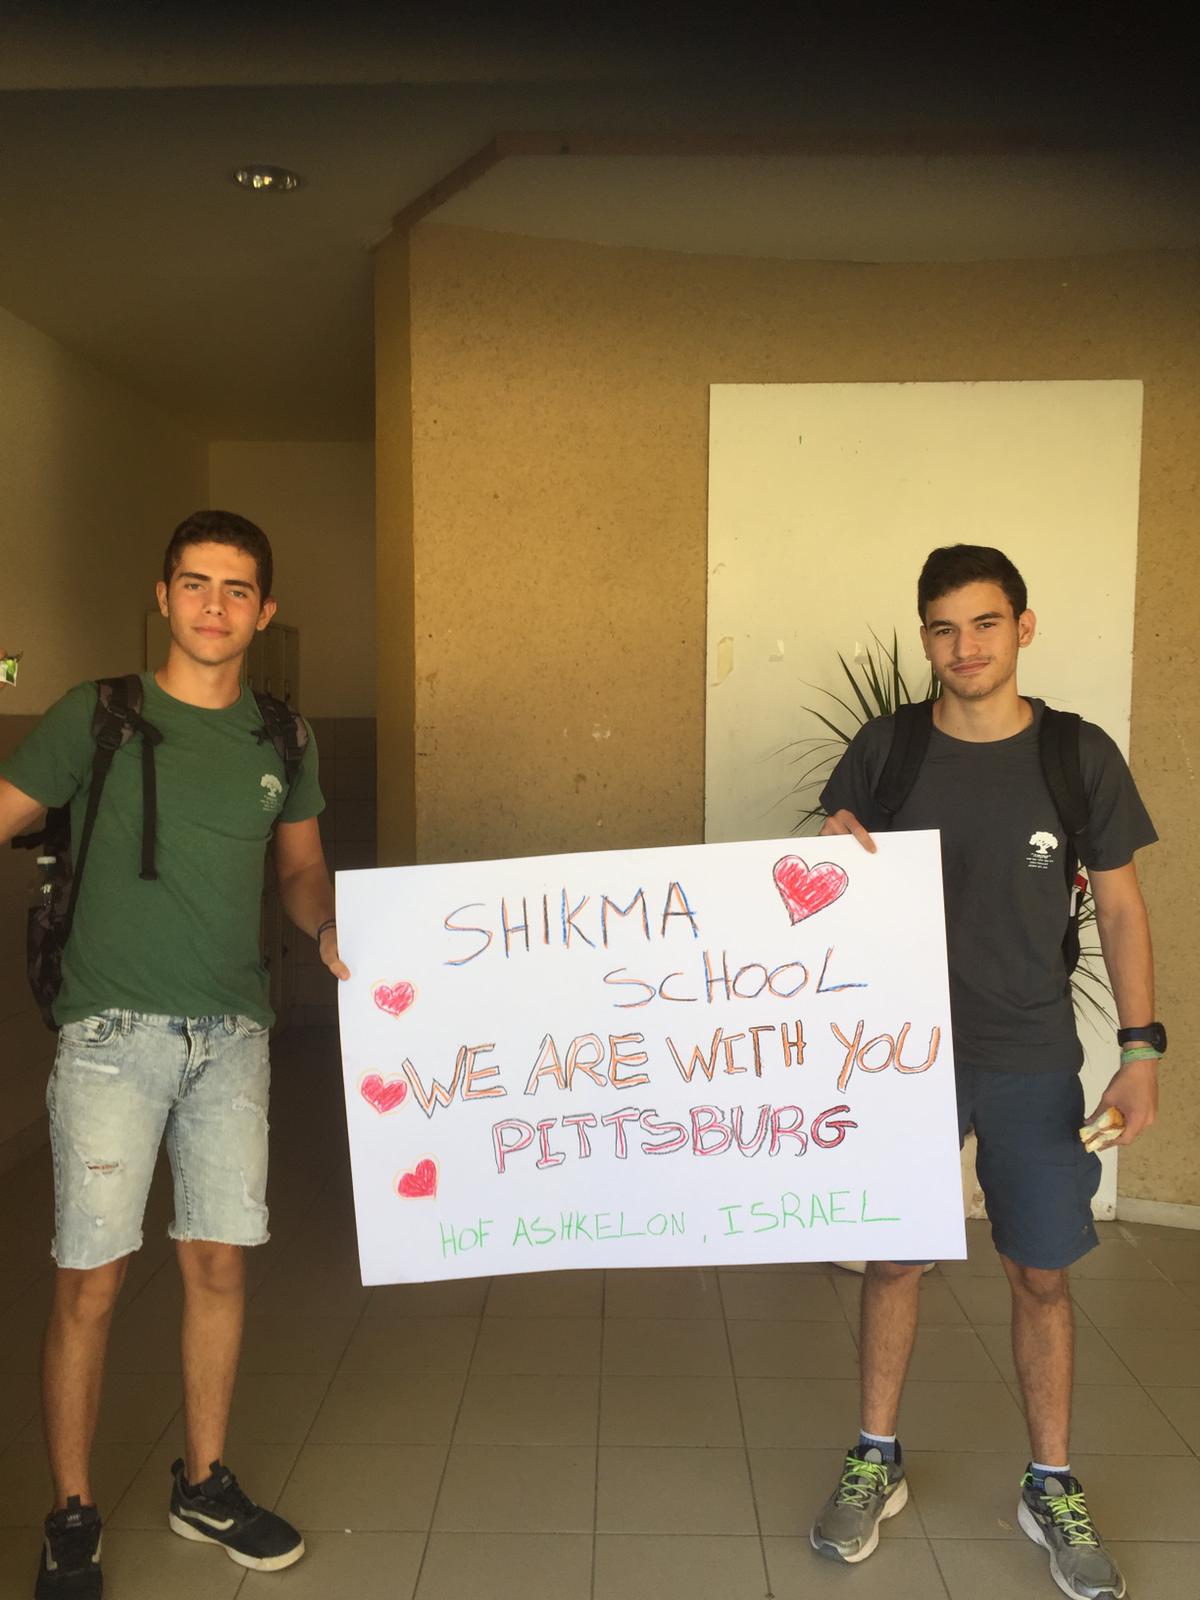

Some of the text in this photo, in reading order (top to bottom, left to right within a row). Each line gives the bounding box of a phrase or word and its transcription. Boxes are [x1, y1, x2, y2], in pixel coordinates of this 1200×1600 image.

[445, 881, 700, 966] SHIKMA
[604, 946, 868, 1008] SCHOOL
[402, 1019, 941, 1119] WE ARE WITH YOU
[491, 1104, 858, 1175] PITTSBURG
[440, 1219, 493, 1258] HOF
[718, 1190, 901, 1236] ISRAEL
